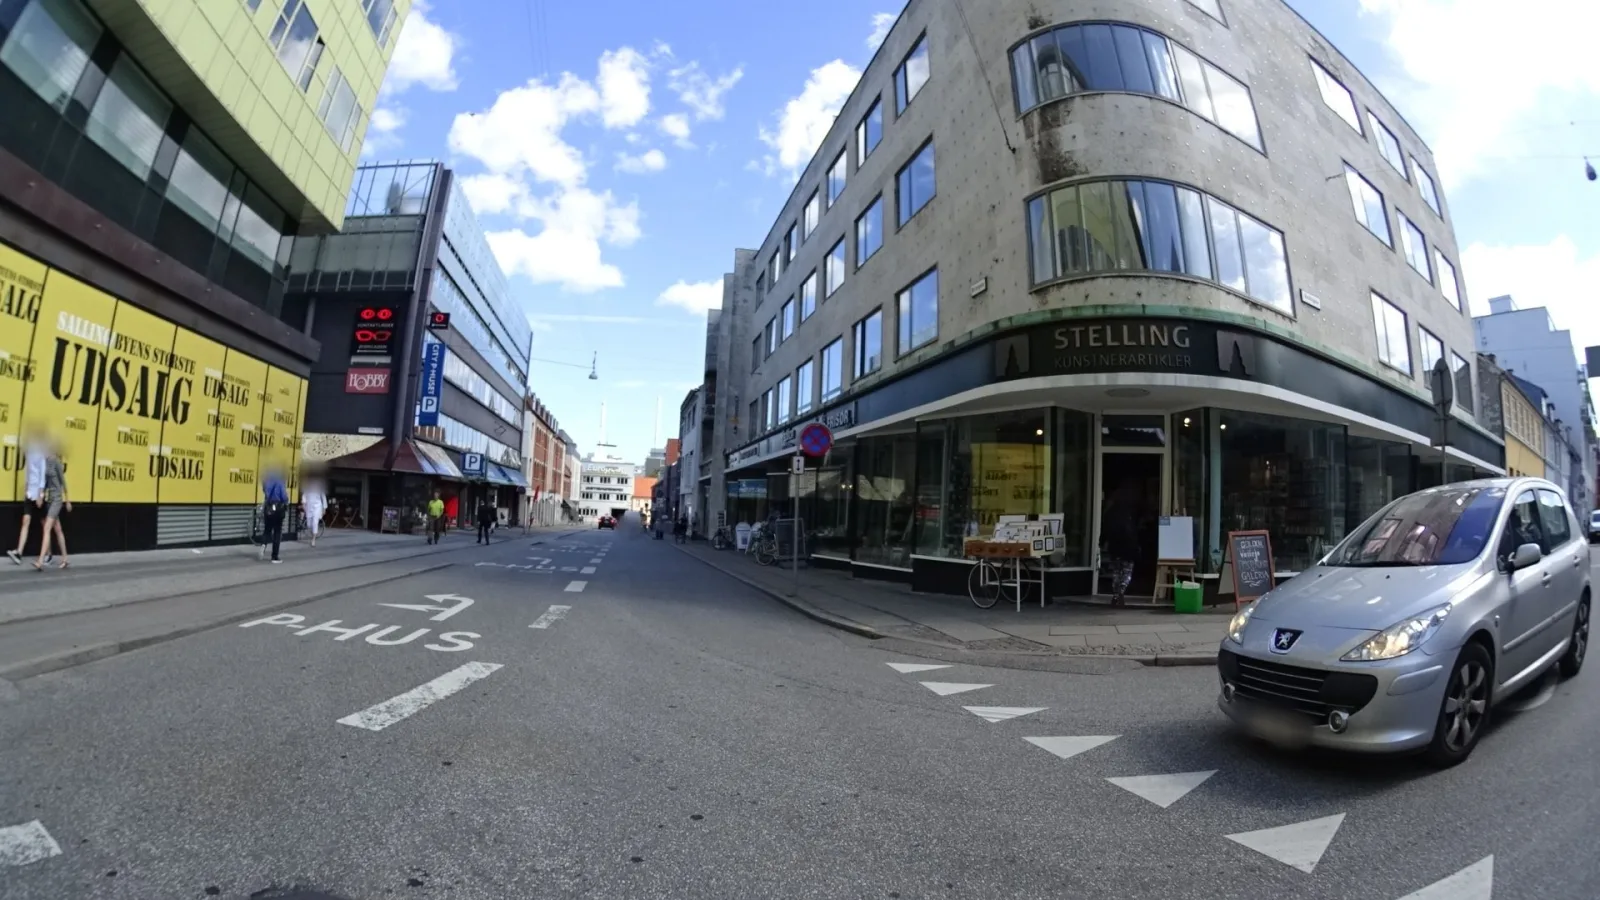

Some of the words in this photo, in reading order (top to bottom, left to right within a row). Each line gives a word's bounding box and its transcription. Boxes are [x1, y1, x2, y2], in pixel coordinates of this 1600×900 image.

[0, 280, 41, 324] ALG
[57, 311, 115, 348] SALLING
[114, 333, 152, 361] BYENS
[152, 347, 196, 376] STØRSTE
[1054, 325, 1190, 349] STELLING
[431, 345, 440, 362] CITY
[1054, 353, 1191, 368] KUNSTNERARTIKLER
[50, 337, 193, 425] UDSALG
[349, 373, 387, 390] HOBBY
[203, 375, 250, 407] UDSALG
[207, 414, 234, 430] UDSALG
[273, 411, 294, 425] UDSALG
[117, 431, 148, 447] UDSALG
[241, 429, 275, 449] UDSALG
[149, 454, 203, 481] UDSALG
[469, 455, 478, 468] P
[97, 465, 135, 482] UDSALG
[229, 471, 254, 484] UDSALG
[238, 613, 482, 651] P-HUS
